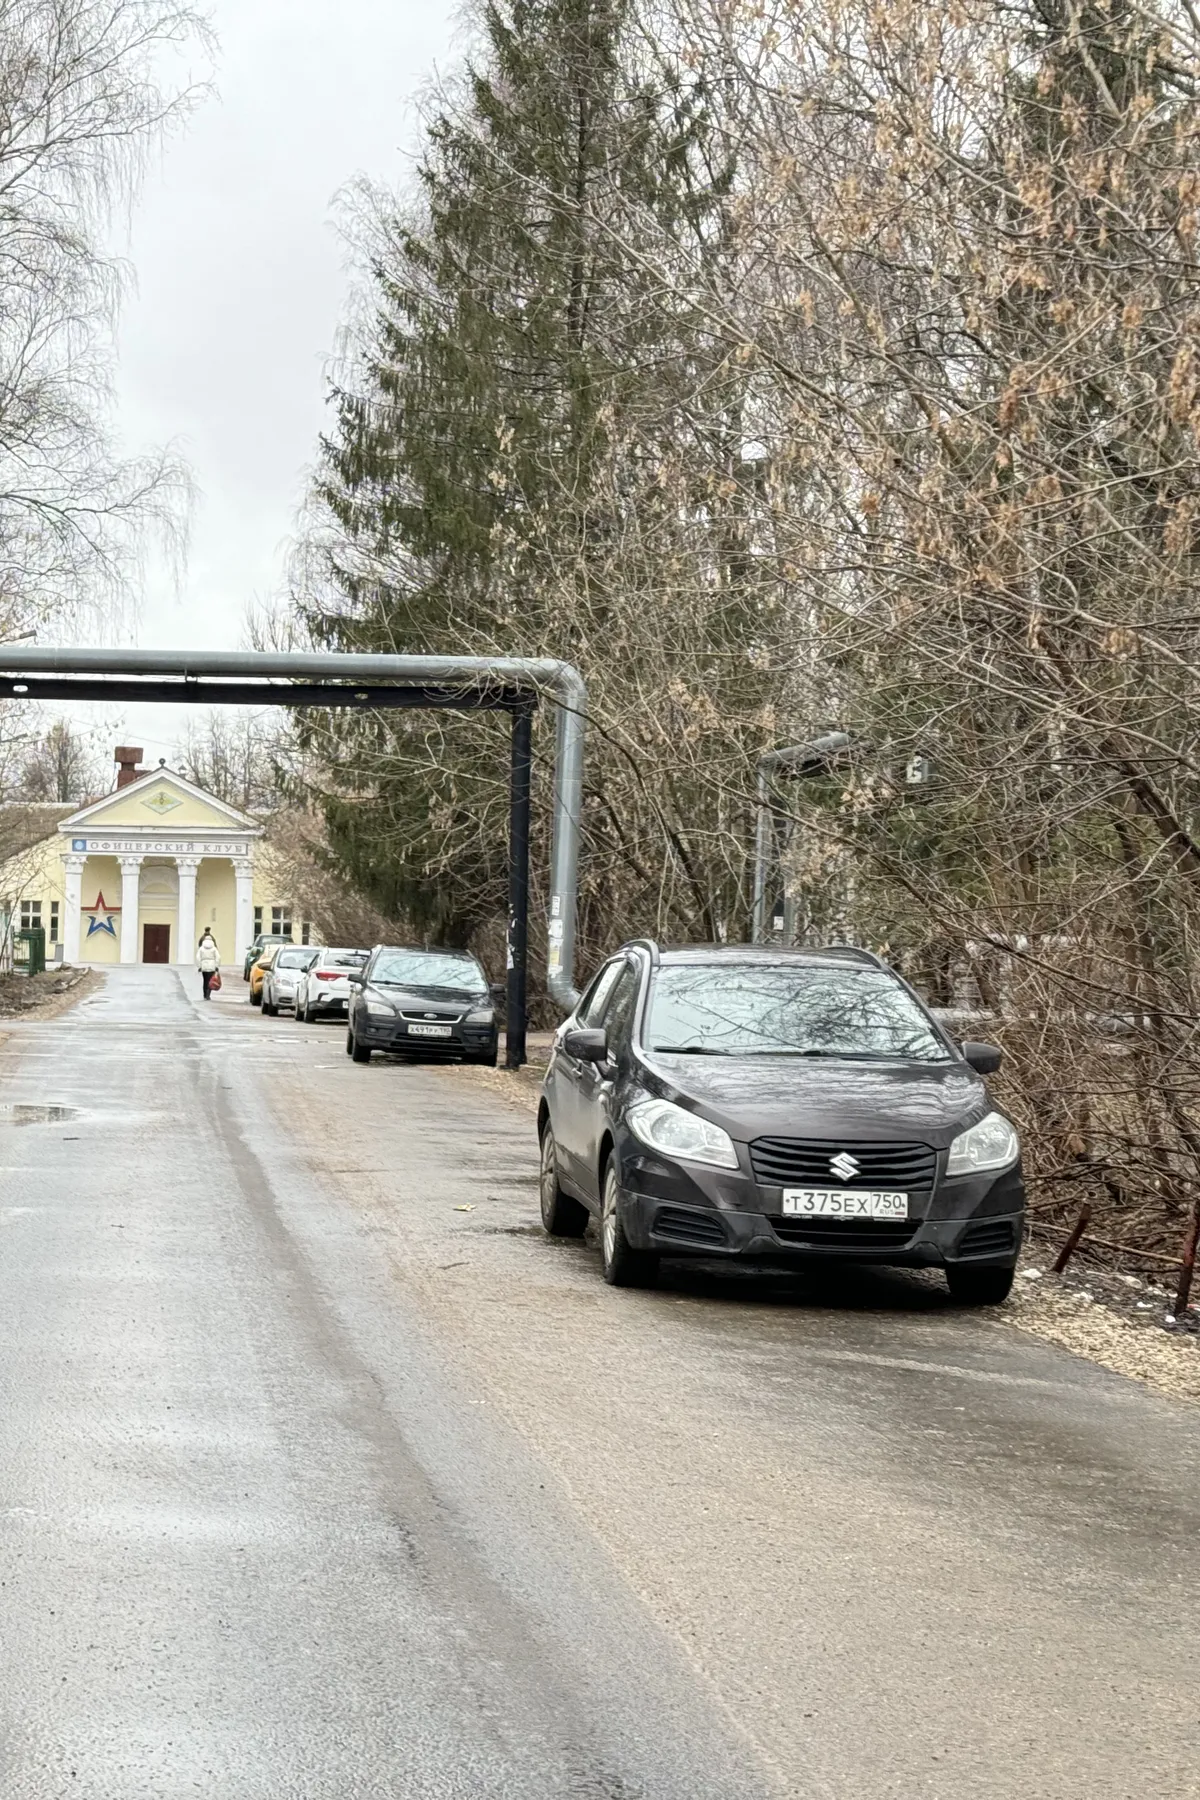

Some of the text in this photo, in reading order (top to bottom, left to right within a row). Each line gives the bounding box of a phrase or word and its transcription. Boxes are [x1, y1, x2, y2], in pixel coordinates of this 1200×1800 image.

[90, 841, 243, 853] ОФИЦЕРСКИЙ КЛУБ
[873, 1193, 902, 1209] 750
